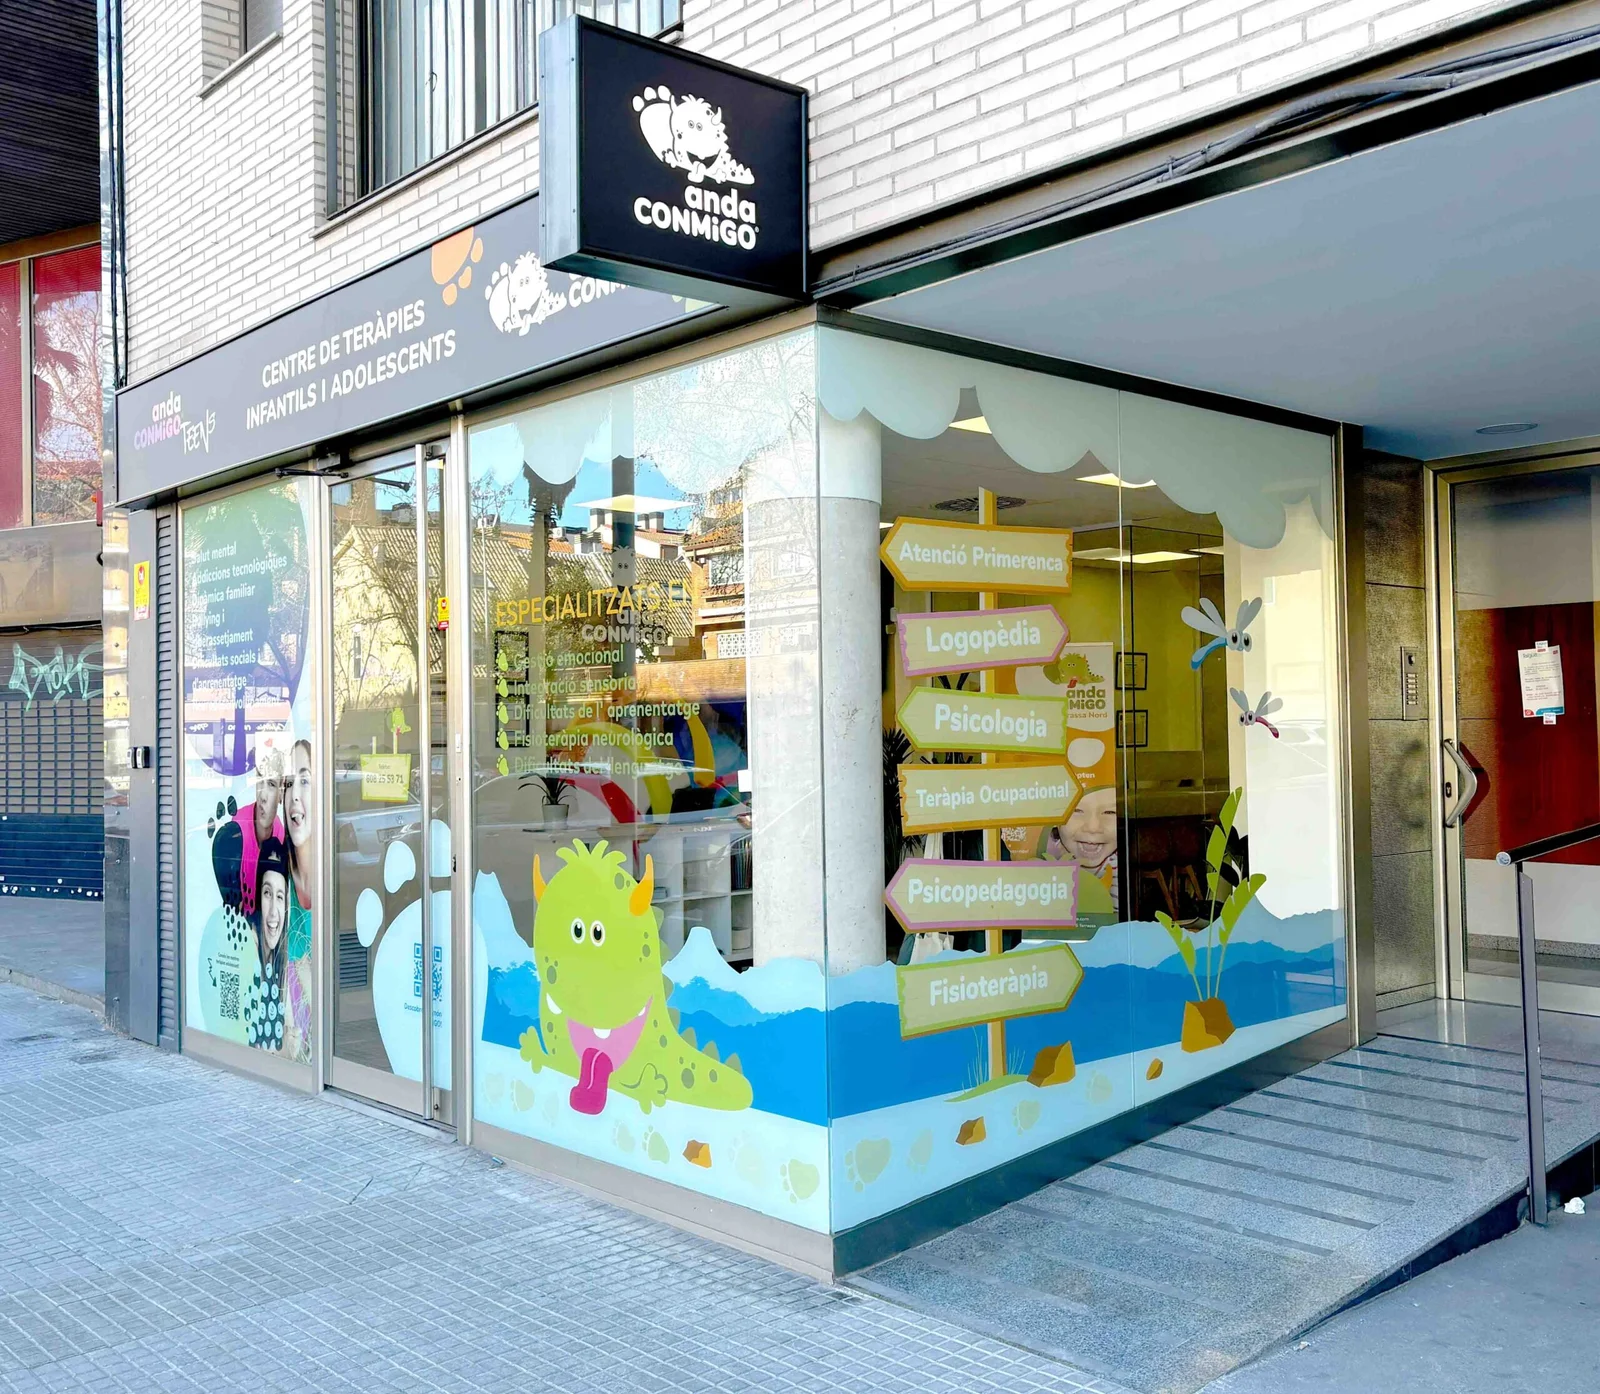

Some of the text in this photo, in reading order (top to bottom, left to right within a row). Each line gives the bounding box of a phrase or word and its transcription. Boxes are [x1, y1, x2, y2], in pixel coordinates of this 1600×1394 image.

[684, 185, 756, 224] anda
[261, 299, 426, 389] CENTRE DE TERÀPIES
[246, 329, 457, 431] INFANTILS I ADOLESCENTS
[152, 391, 181, 422] anda
[180, 409, 216, 454] TEENS
[211, 541, 237, 559] mental
[899, 540, 1063, 572] Atenció Primerenca
[192, 554, 288, 586] Addiccions tecnològiques
[225, 583, 256, 601] familiar
[496, 581, 662, 627] ESPECIALITZATS
[926, 619, 1041, 657] Logopèdia
[230, 649, 256, 665] socials
[514, 645, 624, 670] Gestió emocional
[514, 677, 576, 697] Integració
[1066, 686, 1106, 698] anda
[514, 704, 575, 720] Dificultats
[578, 706, 592, 718] de
[607, 702, 700, 721] aprenentatge
[935, 703, 1048, 742] Psicologia
[1088, 711, 1108, 719] Nord
[514, 727, 674, 749] Fisioteràpia neurològica
[395, 774, 404, 784] 71
[514, 757, 580, 775] Dificultats
[916, 781, 1069, 809] Teràpia Ocupacional
[907, 875, 1068, 908] Psicopedagogia
[929, 966, 1048, 1006] Fisioteràpia
